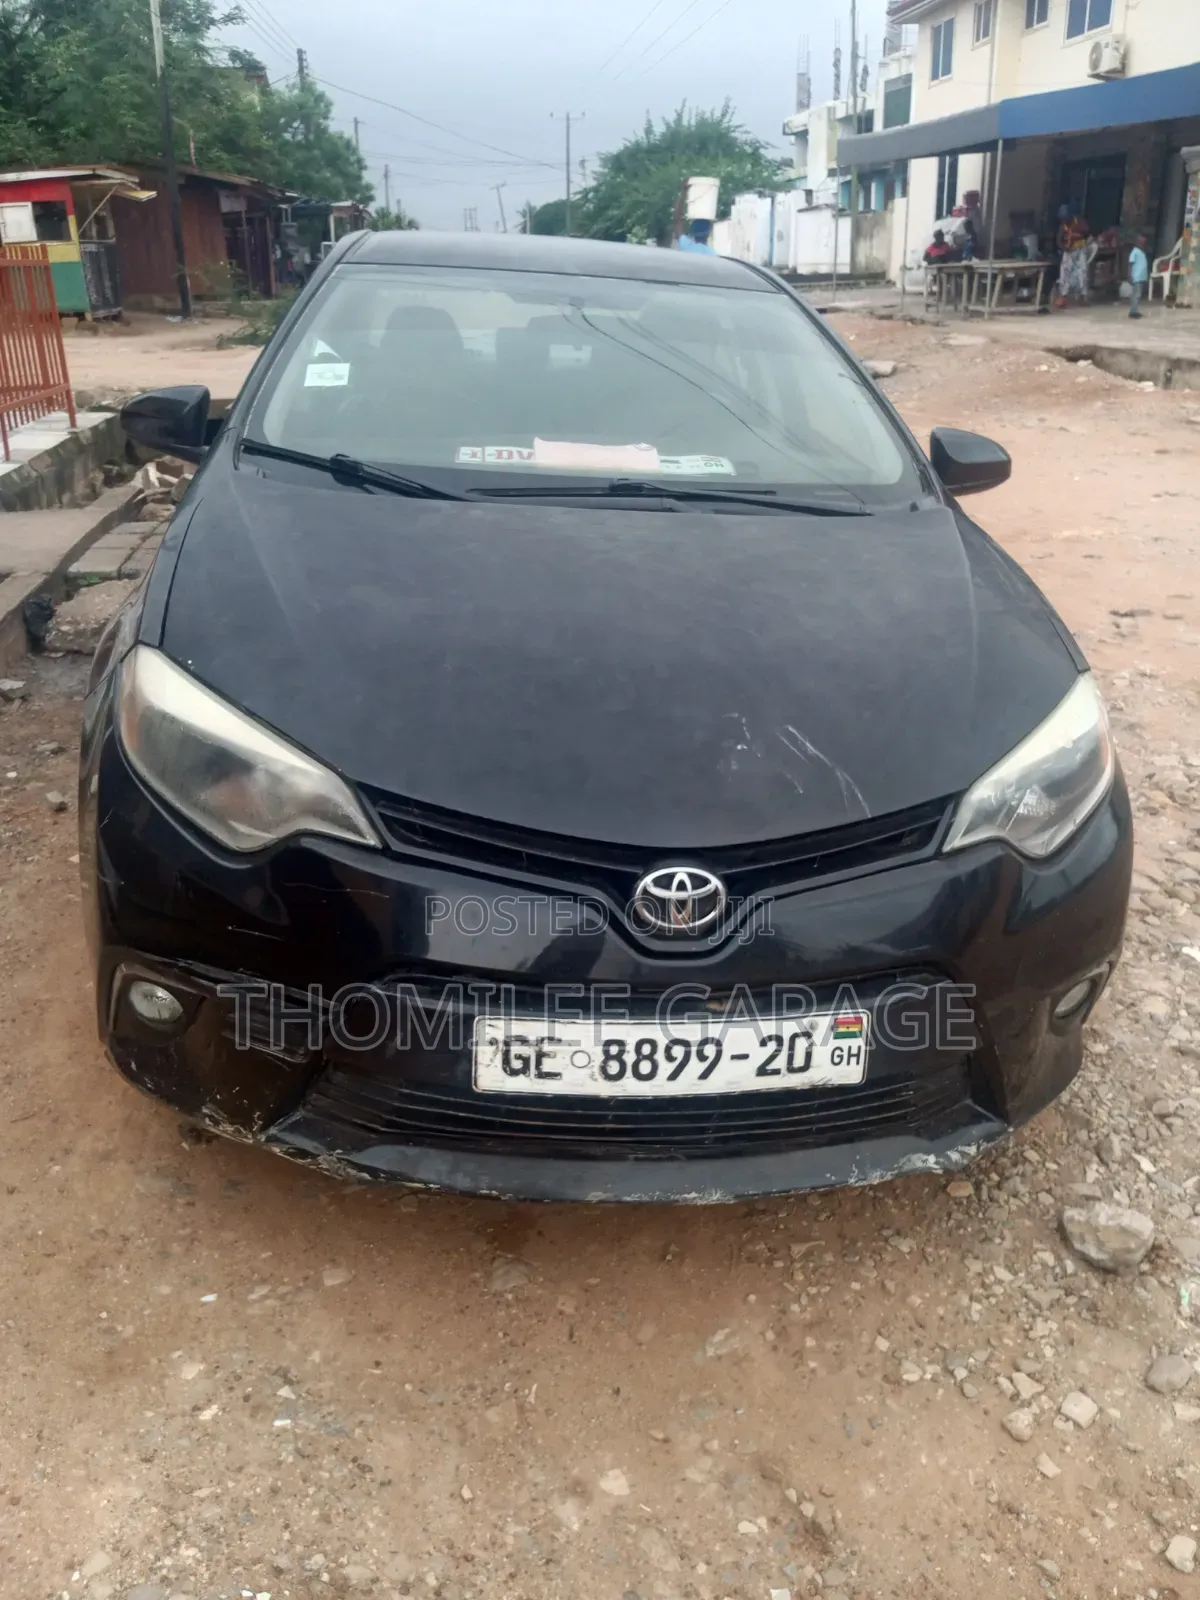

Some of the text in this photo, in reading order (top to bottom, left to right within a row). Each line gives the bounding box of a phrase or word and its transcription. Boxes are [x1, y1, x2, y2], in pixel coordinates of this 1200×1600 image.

[502, 1031, 813, 1082] GE 8899-20
[830, 1045, 862, 1067] GH
